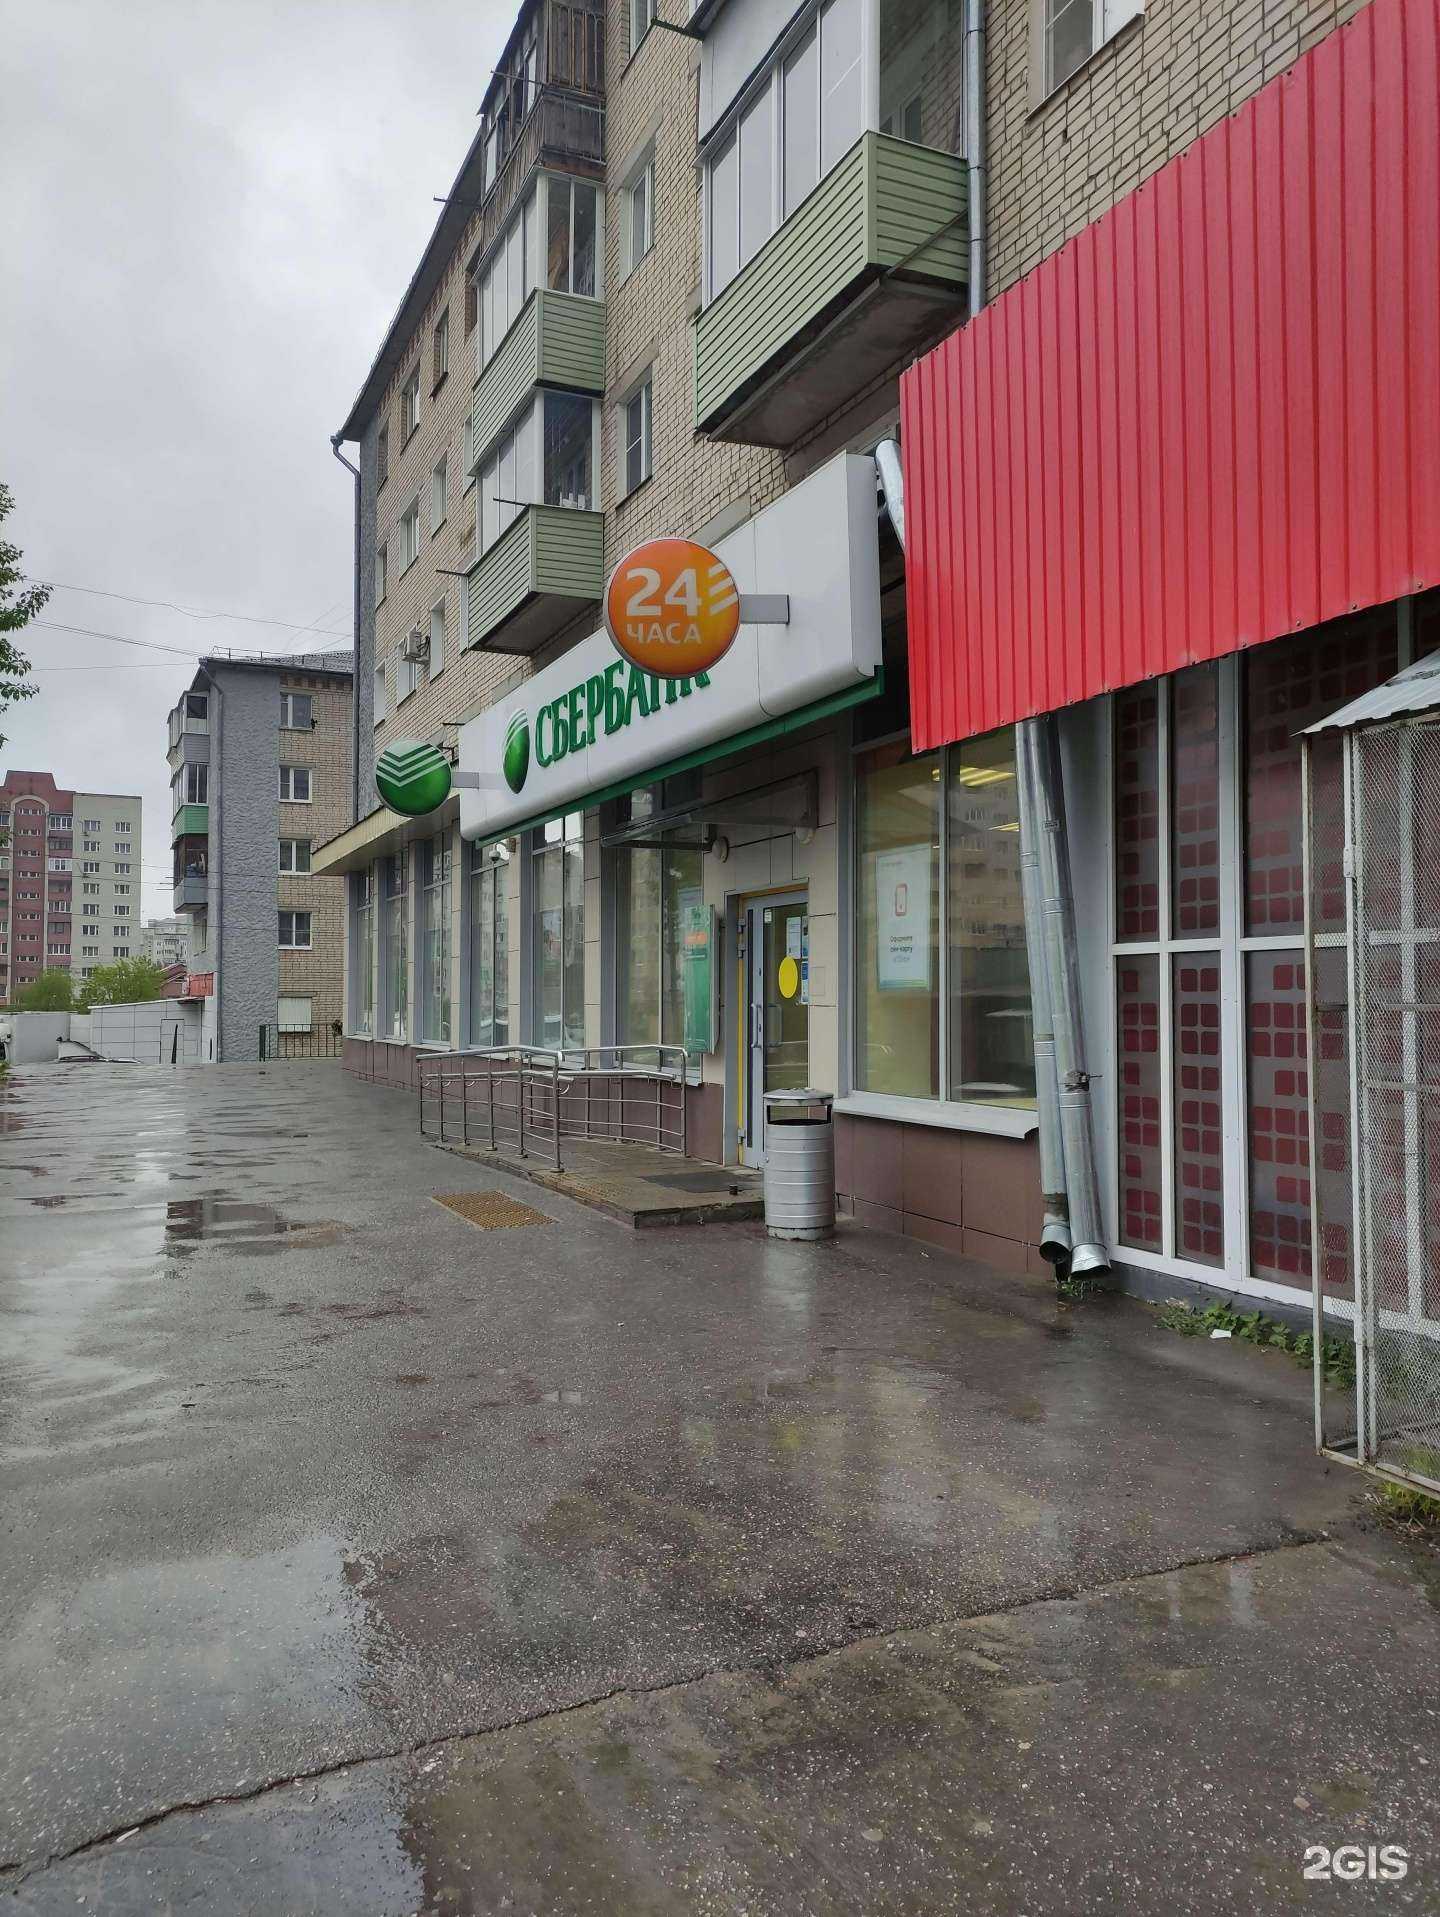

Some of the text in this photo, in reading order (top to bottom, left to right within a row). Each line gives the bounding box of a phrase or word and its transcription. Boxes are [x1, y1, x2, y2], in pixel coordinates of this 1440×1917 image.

[626, 567, 702, 617] 24
[626, 622, 702, 645] ЧАСА
[535, 659, 711, 768] СБЕРБА
